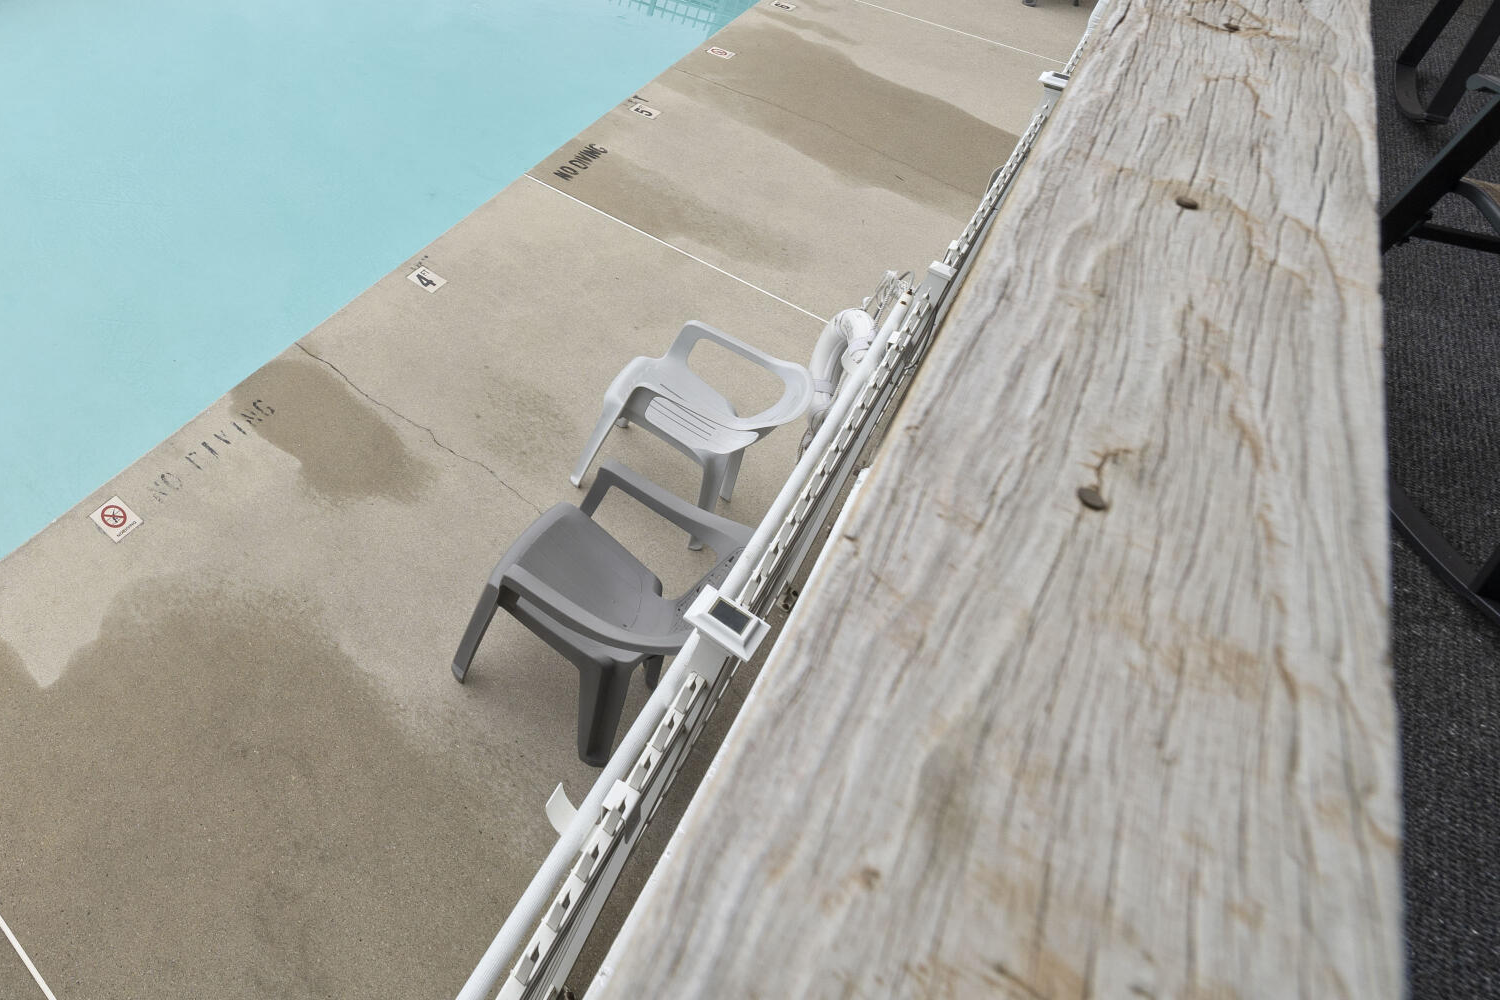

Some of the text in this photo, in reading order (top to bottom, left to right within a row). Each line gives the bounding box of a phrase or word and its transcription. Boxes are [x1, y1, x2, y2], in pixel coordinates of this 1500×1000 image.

[634, 107, 653, 117] 5
[553, 143, 608, 181] NO DIVING
[416, 273, 437, 287] 4
